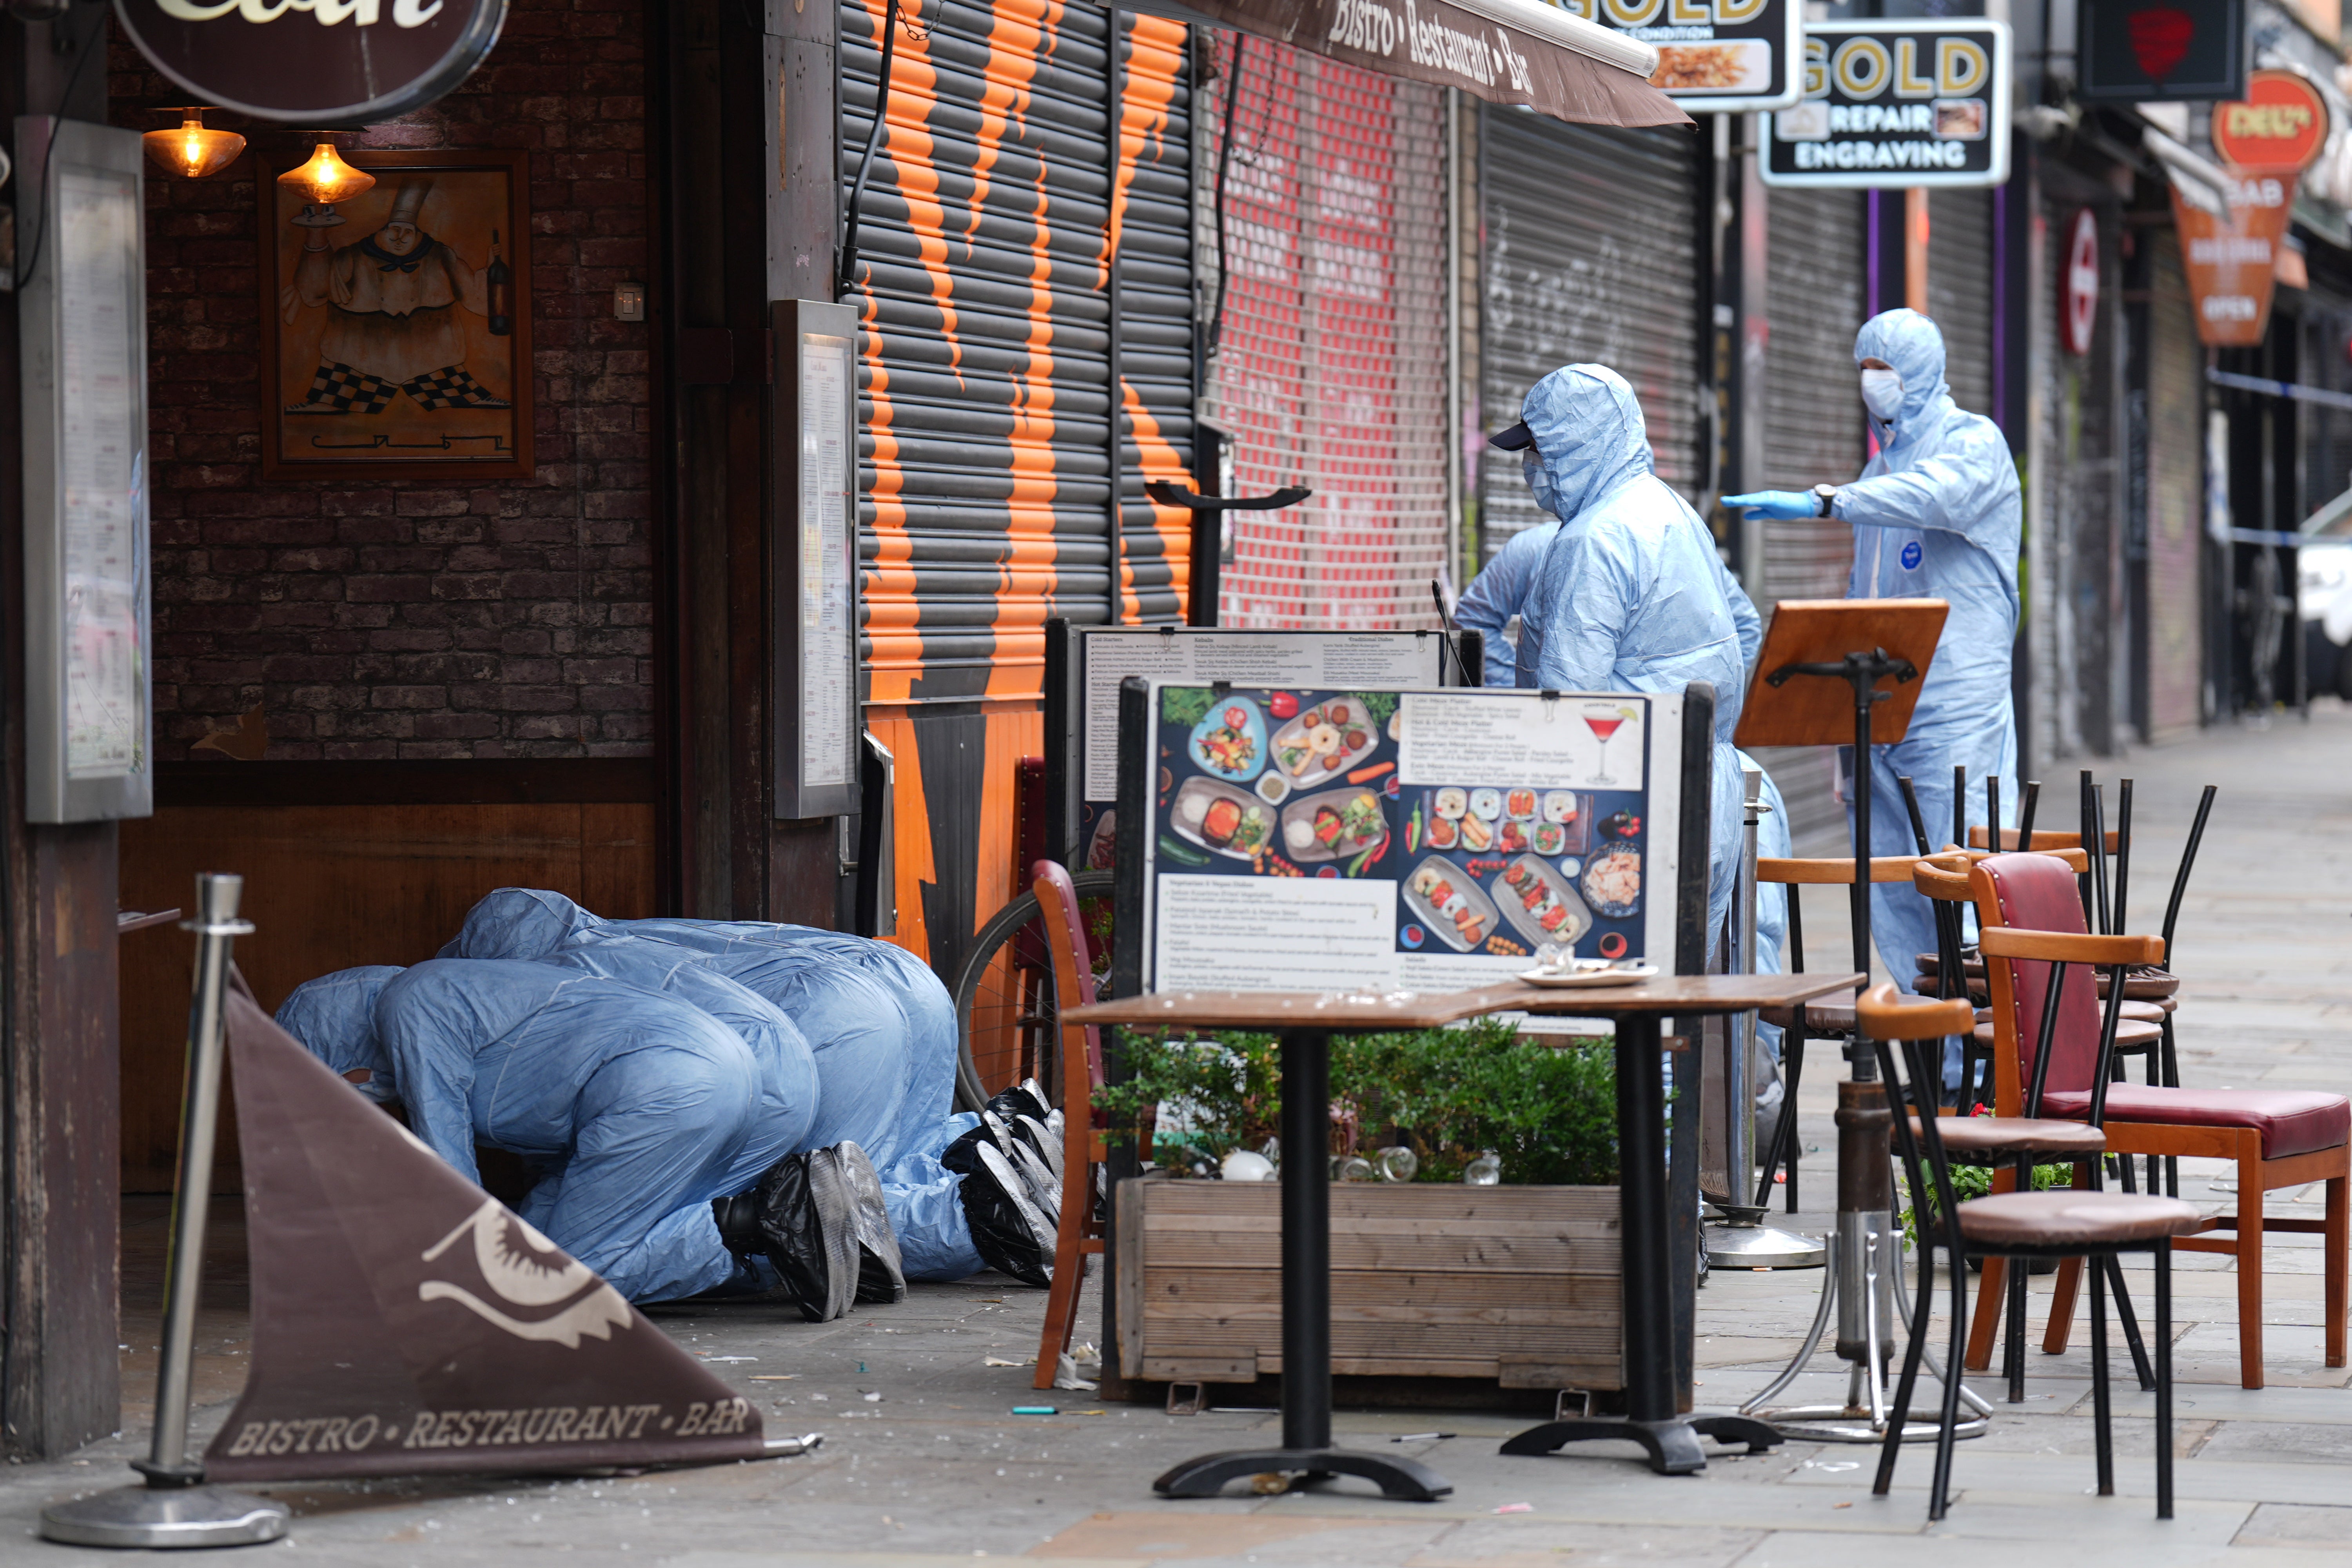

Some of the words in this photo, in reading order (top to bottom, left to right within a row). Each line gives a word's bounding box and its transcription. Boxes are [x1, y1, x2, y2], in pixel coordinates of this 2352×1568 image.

[1629, 26, 1714, 39] CONDITION
[1329, 0, 1394, 56] Bistro
[1406, 0, 1495, 87] Restaurant
[1497, 27, 1534, 96] Bar
[1829, 105, 1931, 133] REPAIR
[1794, 141, 1965, 169] ENGRAVING
[2202, 296, 2257, 321] OPEN
[228, 1414, 379, 1457] BISTRO
[403, 1404, 662, 1449] RESTAURANT
[676, 1397, 750, 1437] BAR
